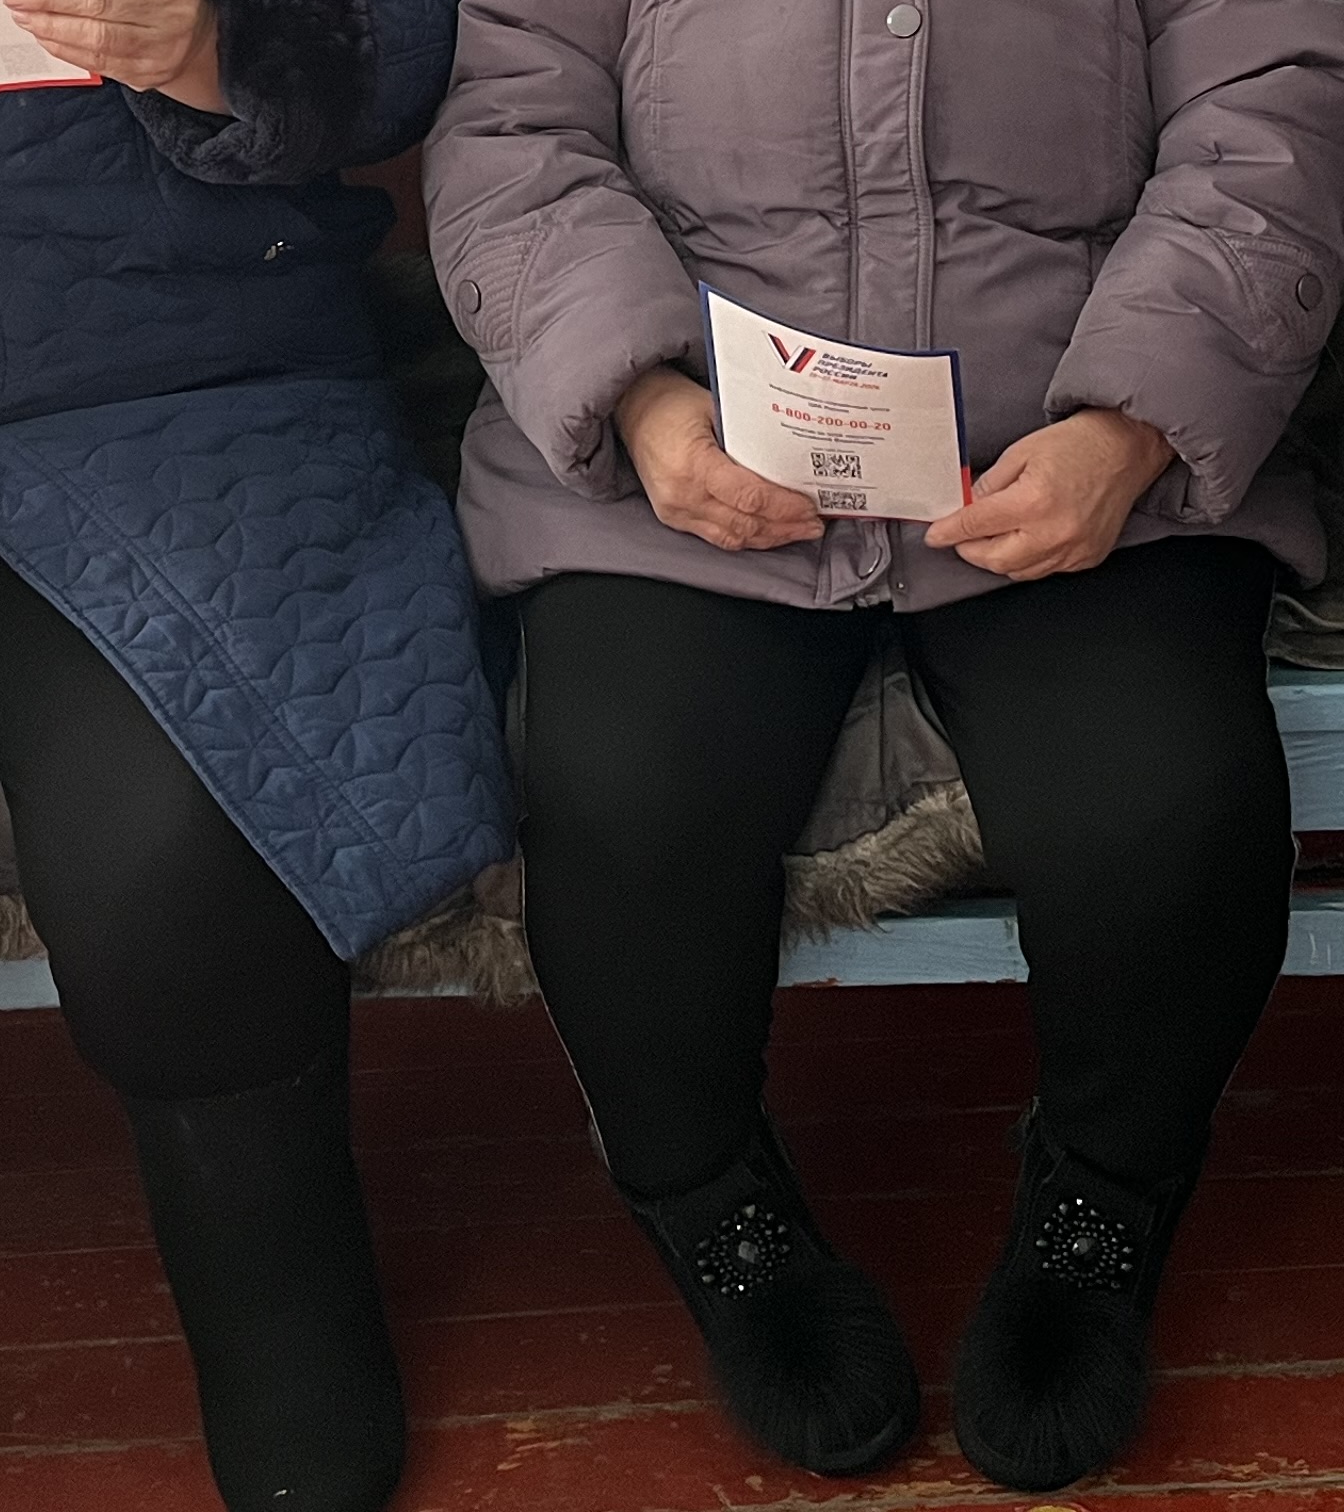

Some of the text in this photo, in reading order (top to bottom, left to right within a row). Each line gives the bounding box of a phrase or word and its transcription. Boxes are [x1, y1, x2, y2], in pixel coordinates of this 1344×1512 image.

[822, 353, 872, 368] ВЫБОРЫ
[812, 366, 857, 380] РОССИИ
[772, 402, 891, 431] 8-800-200-00-20
